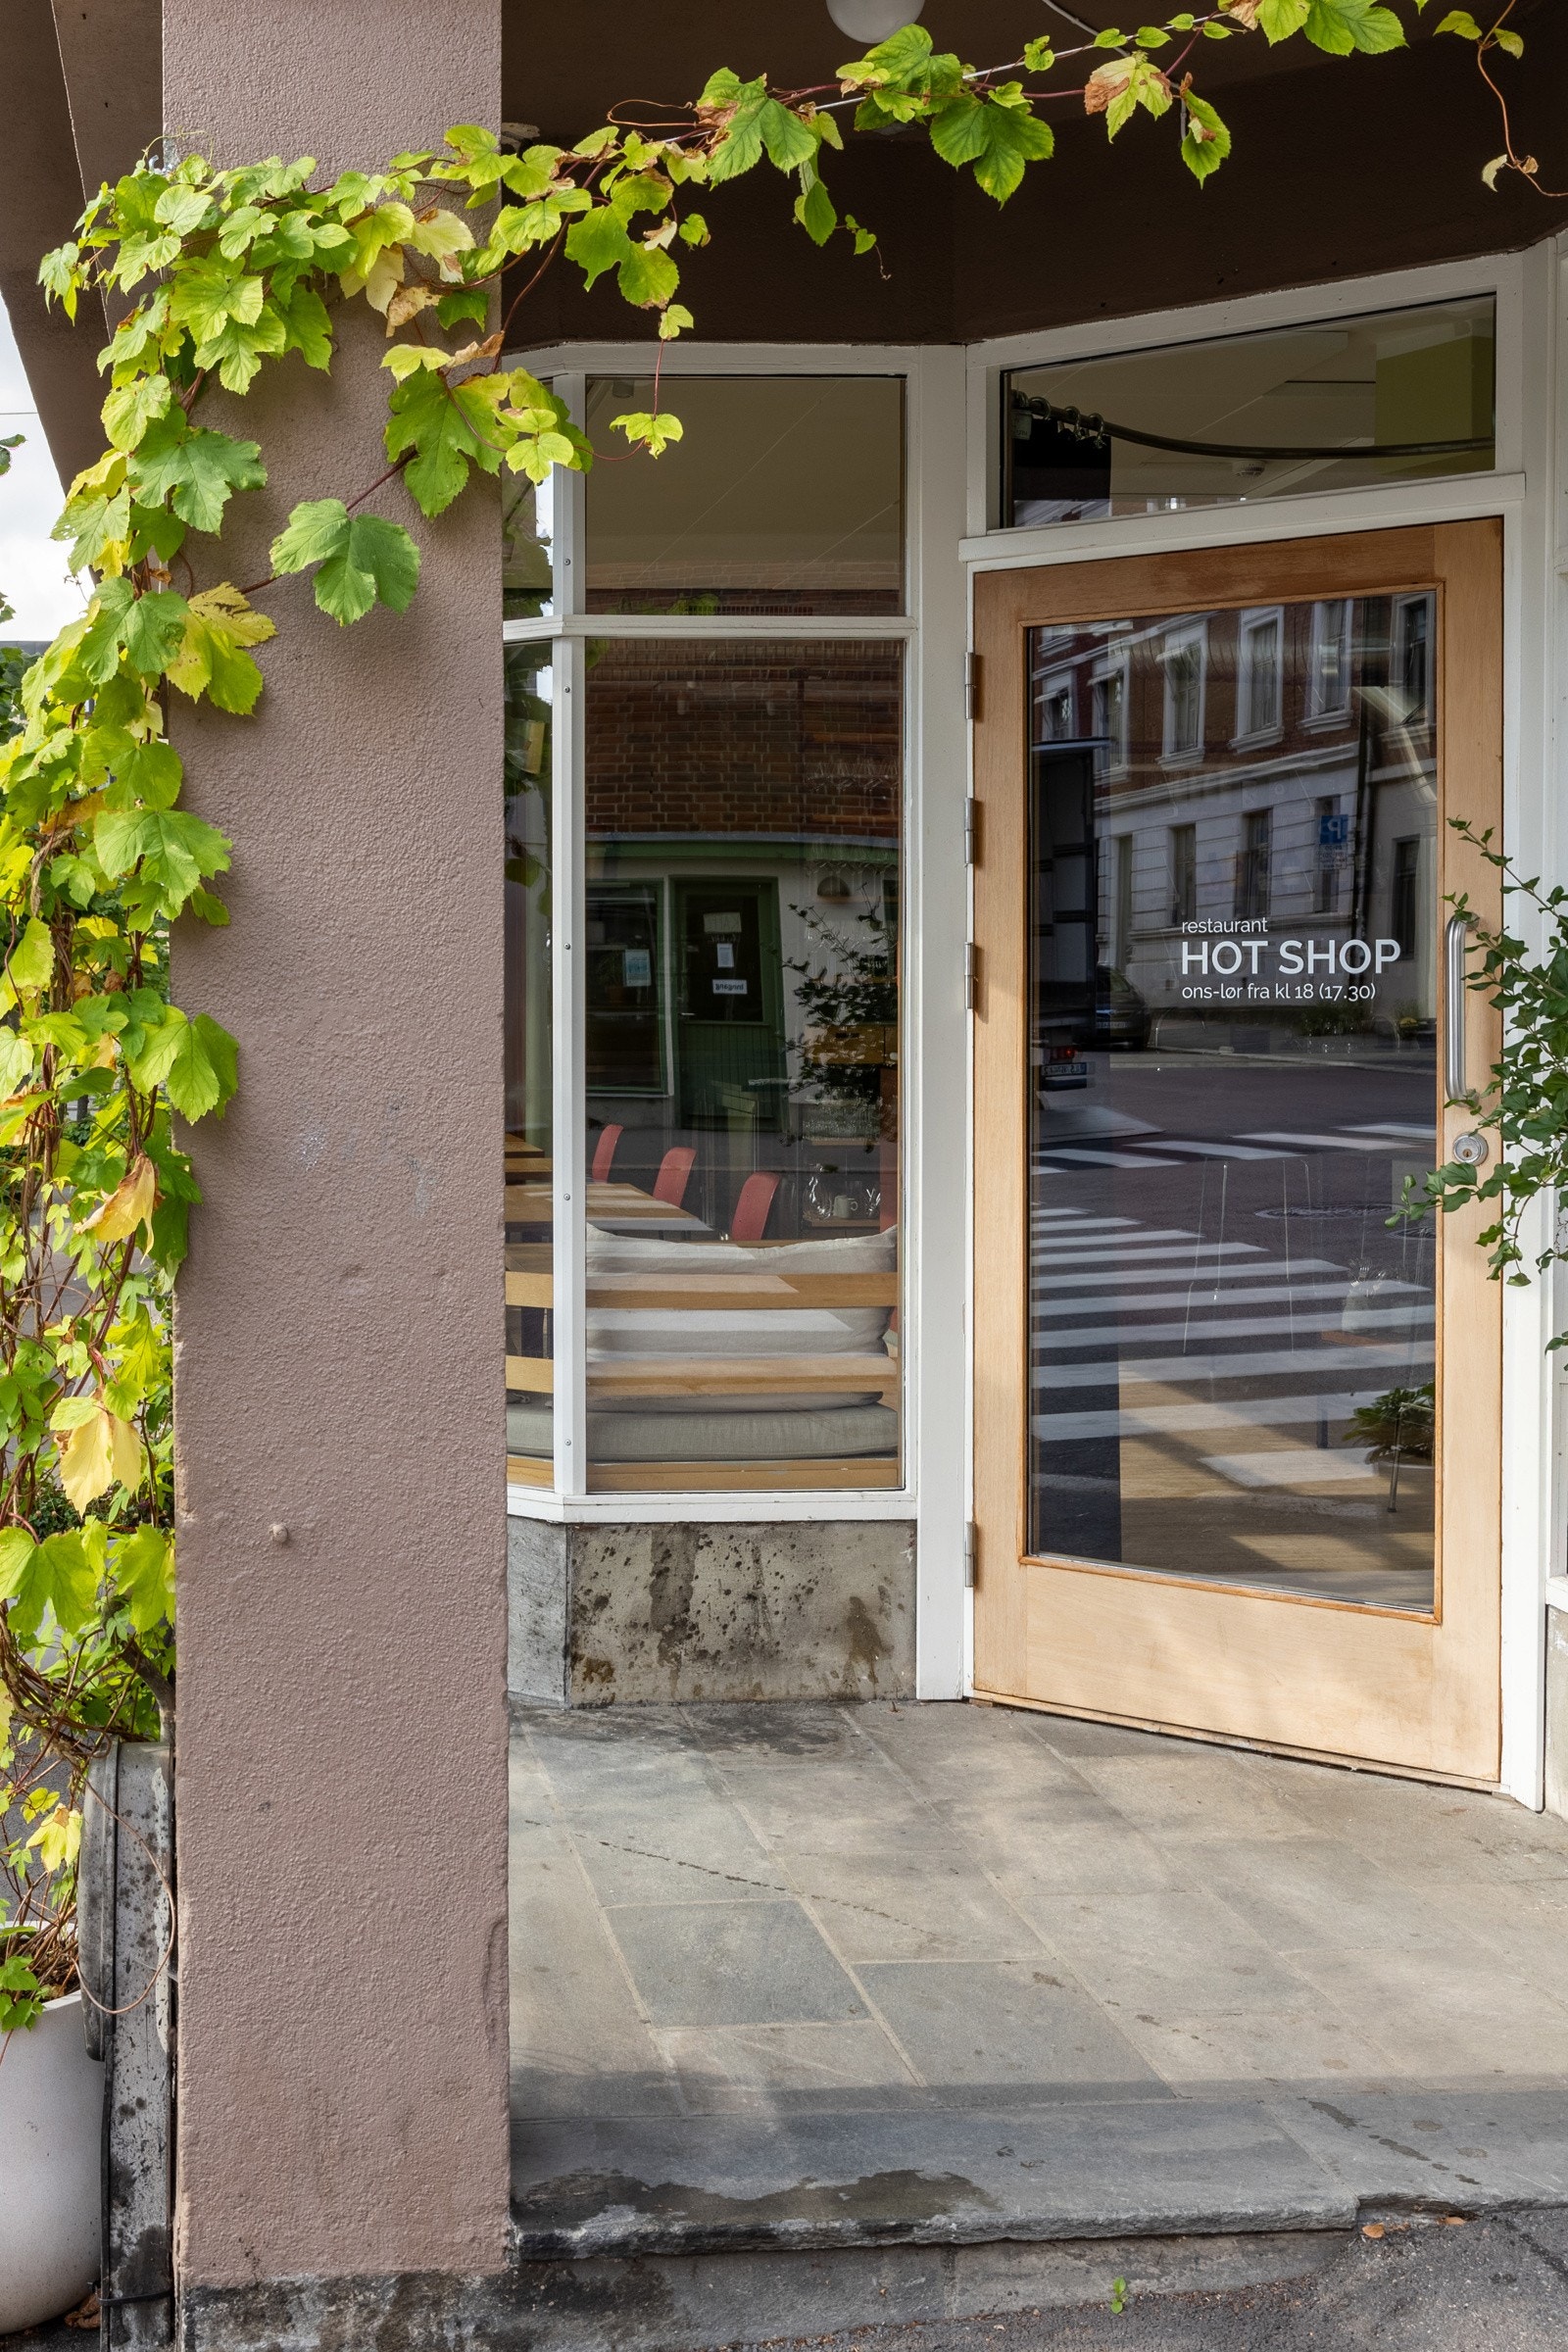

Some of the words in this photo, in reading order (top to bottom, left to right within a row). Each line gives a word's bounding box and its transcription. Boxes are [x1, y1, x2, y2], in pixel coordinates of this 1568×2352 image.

[1182, 917, 1268, 934] restaurant
[1182, 940, 1268, 975] HOT
[1278, 939, 1401, 975] SHOP
[1182, 983, 1243, 1000] ons-lør
[1247, 983, 1270, 1000] fra
[1275, 982, 1290, 1000] kl
[1295, 983, 1314, 1000] 18
[1319, 982, 1376, 1002] (17.30)
